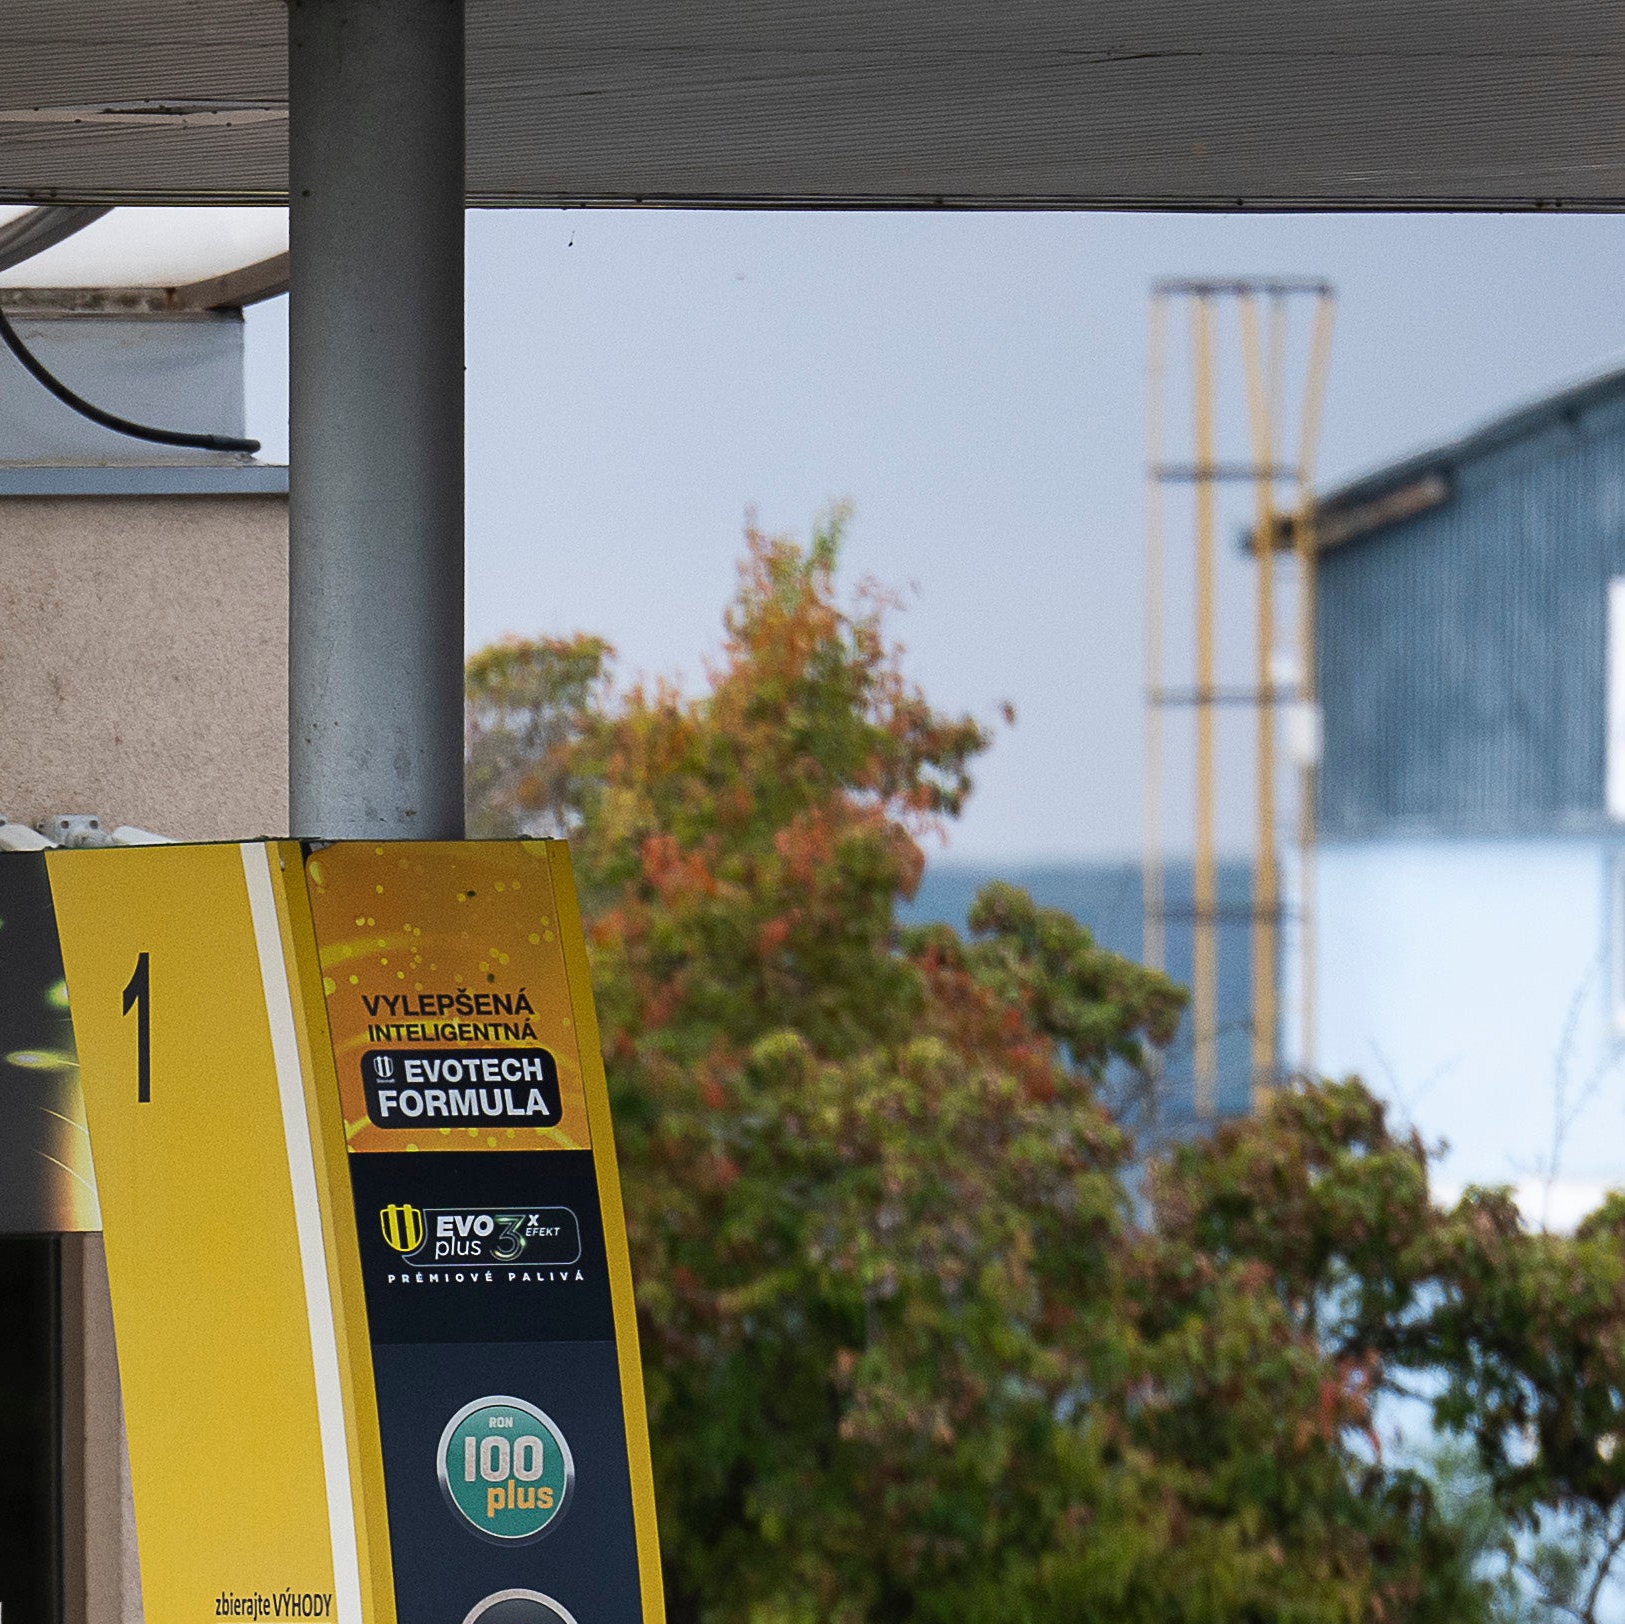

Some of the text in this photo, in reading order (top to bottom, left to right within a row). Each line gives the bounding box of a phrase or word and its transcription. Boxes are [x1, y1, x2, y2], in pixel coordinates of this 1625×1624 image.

[361, 987, 535, 1017] VYLEPŠENÁ
[122, 952, 150, 1103] 1
[367, 1019, 538, 1042] INTELIGENTNÁ
[404, 1057, 543, 1084] EVOTECH
[377, 1087, 550, 1118] FORMULA
[436, 1214, 495, 1238] EVO
[525, 1226, 561, 1238] EFEKT
[434, 1235, 482, 1260] plus
[388, 1268, 585, 1284] PRÉMIOVÉ PALIVÁ
[488, 1416, 514, 1429] RON
[464, 1434, 545, 1484] 100
[486, 1479, 554, 1518] plus
[215, 1587, 333, 1622] zbierajte VÝHODY
